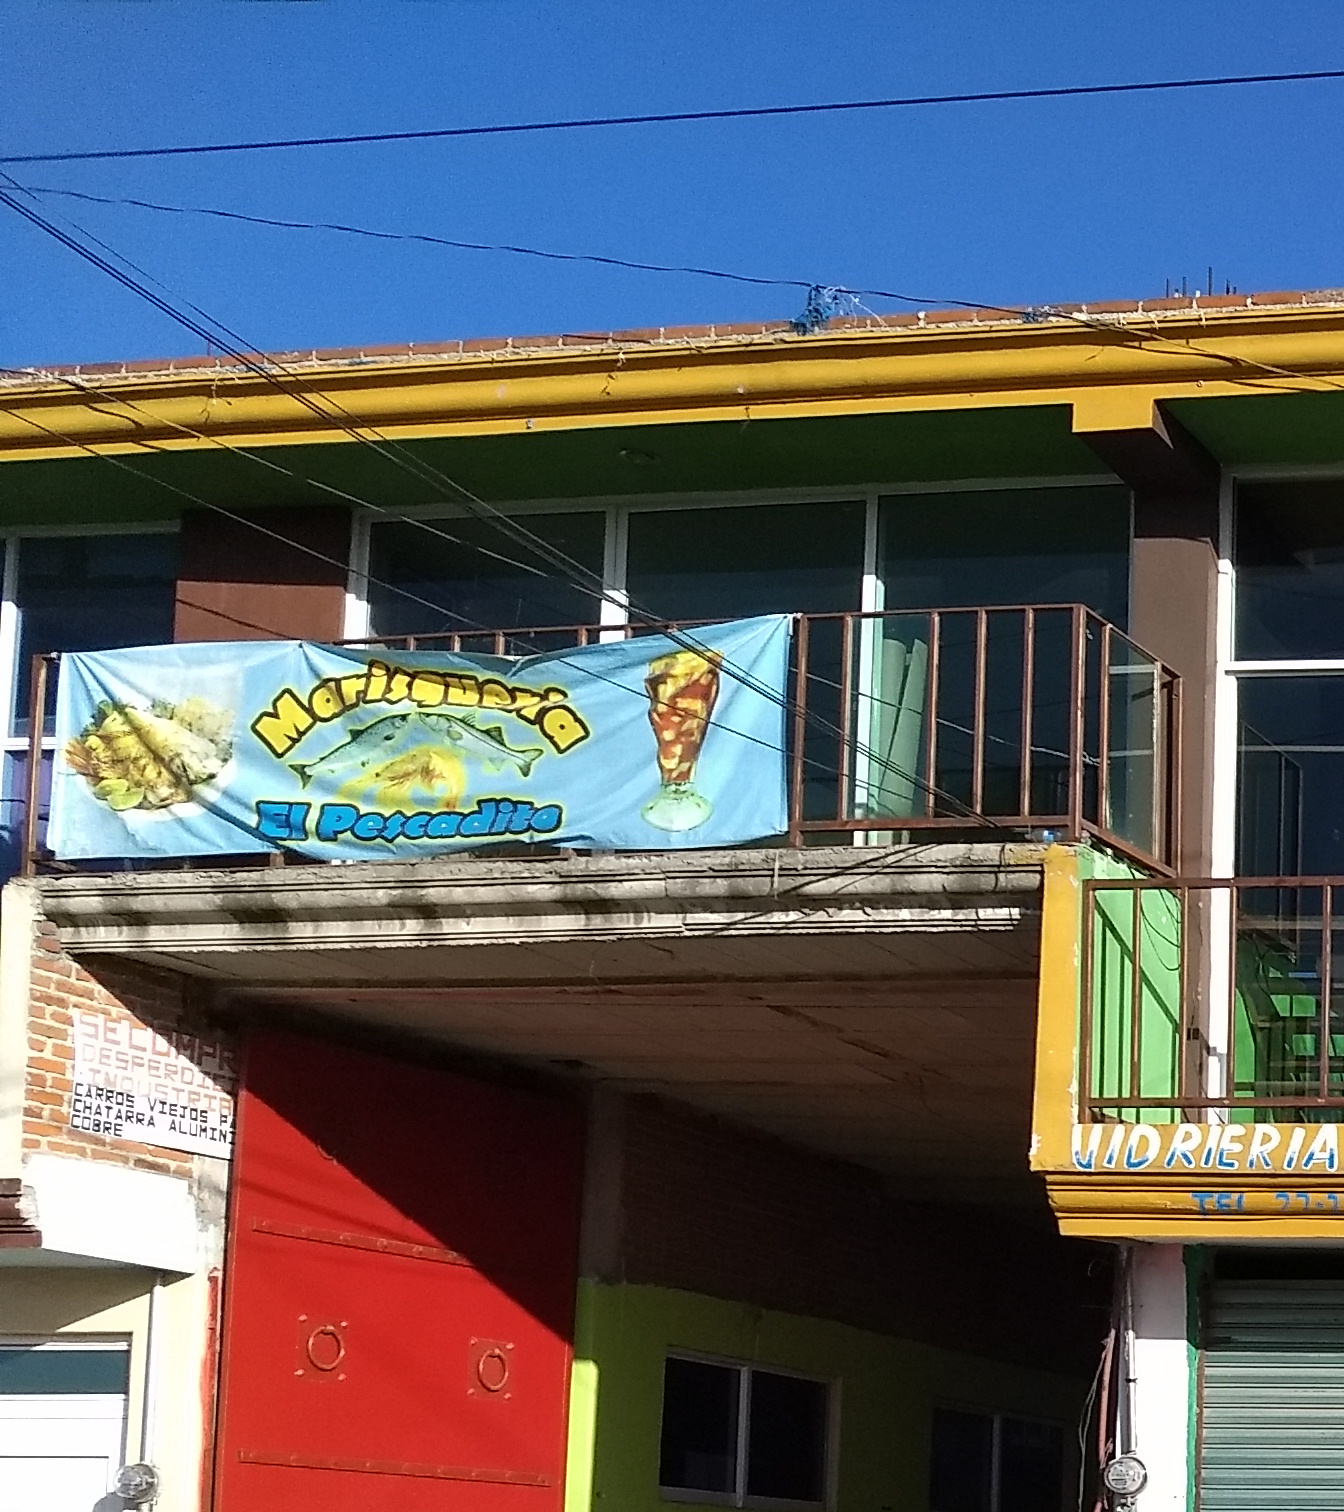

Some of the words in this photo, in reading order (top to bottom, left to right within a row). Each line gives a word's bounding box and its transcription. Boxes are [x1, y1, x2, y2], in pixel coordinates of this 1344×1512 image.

[250, 659, 590, 759] Marisqueria
[256, 801, 311, 839] El
[316, 799, 563, 842] Pescadito
[72, 1098, 155, 1127] CHATARRA
[74, 1083, 135, 1109] CARROS
[147, 1097, 208, 1124] VIEJOS
[71, 1114, 123, 1137] COBRE
